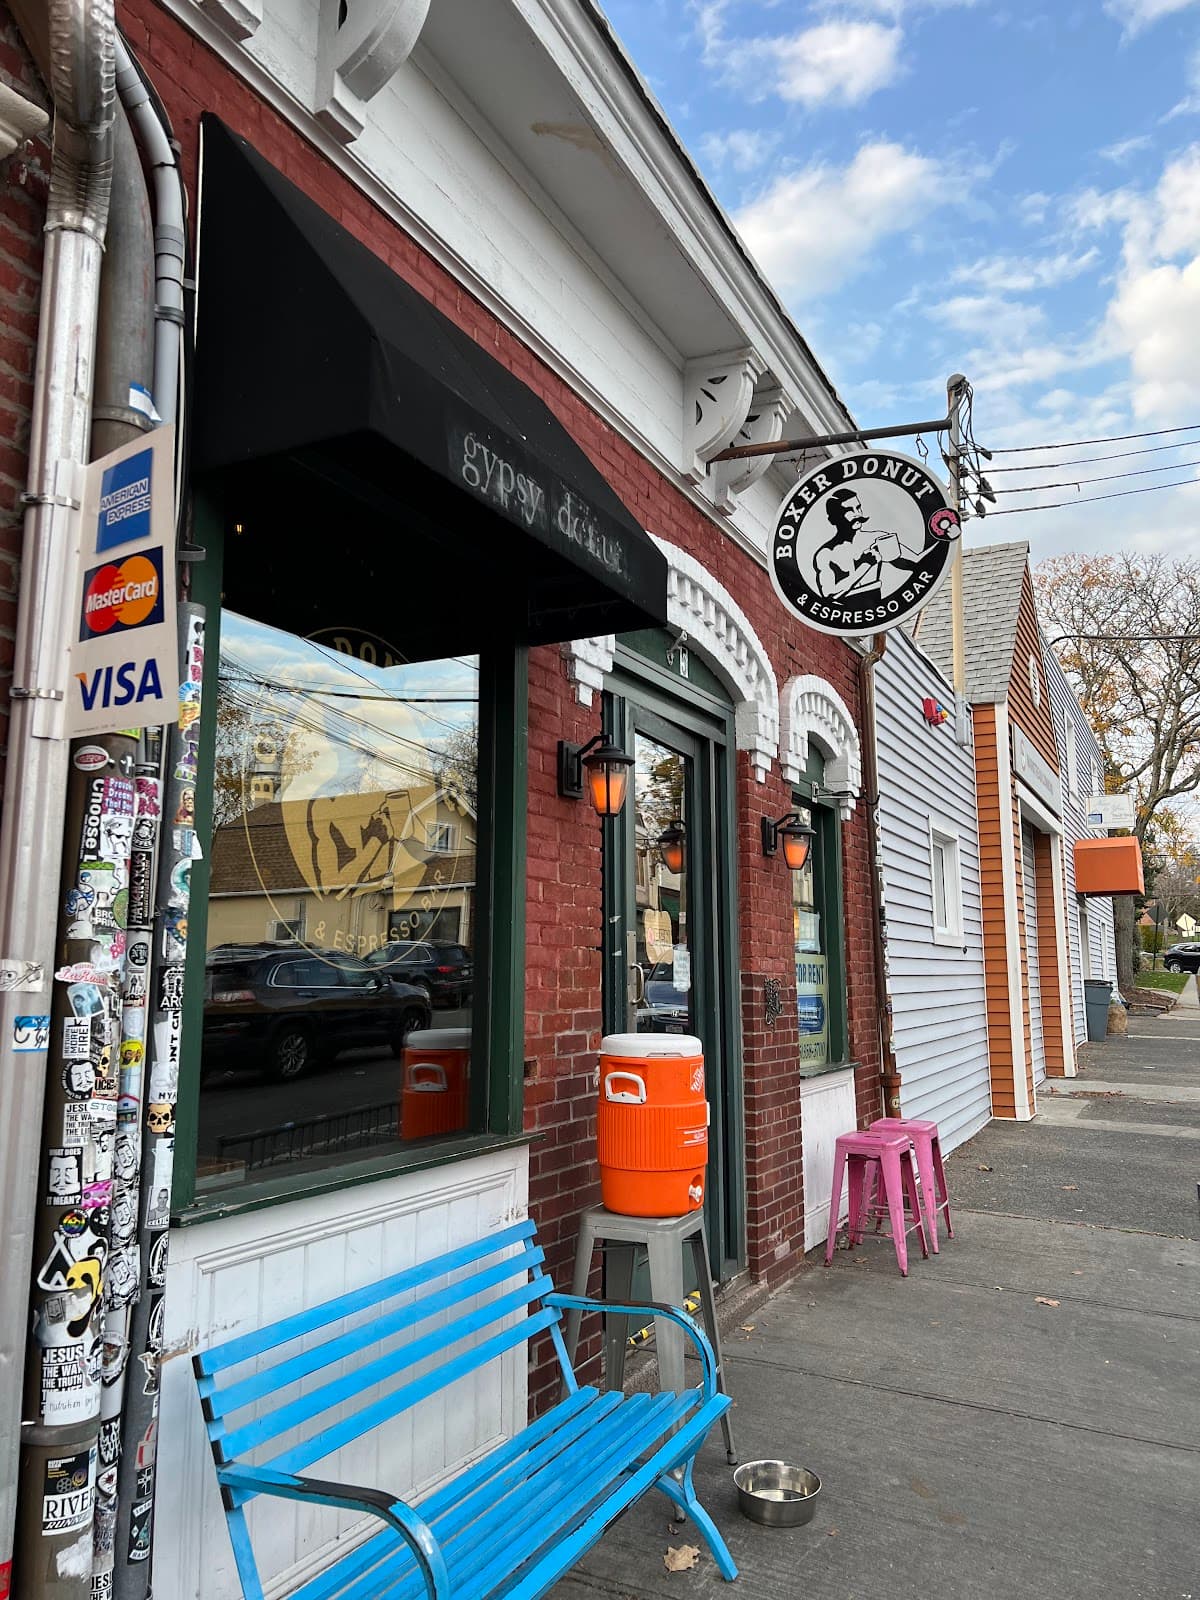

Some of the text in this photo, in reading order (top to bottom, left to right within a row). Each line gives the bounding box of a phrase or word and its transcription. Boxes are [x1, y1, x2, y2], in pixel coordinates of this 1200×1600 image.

[101, 479, 148, 511] AMERICAN
[462, 432, 544, 525] gypsy
[106, 498, 151, 526] EXPRESS
[776, 457, 934, 560] BOXER DONUT
[85, 576, 156, 614] MasterCard
[796, 571, 934, 624] & ESPRESSO BAR
[74, 658, 163, 711] VISA
[85, 777, 104, 849] Choose
[315, 920, 326, 942] &
[333, 910, 420, 952] ESPRESSO
[807, 964, 825, 985] RENT
[78, 1028, 89, 1054] FIRE
[42, 1366, 59, 1378] THE
[43, 1345, 83, 1364] JESUS
[42, 1374, 82, 1389] THE TRUTH
